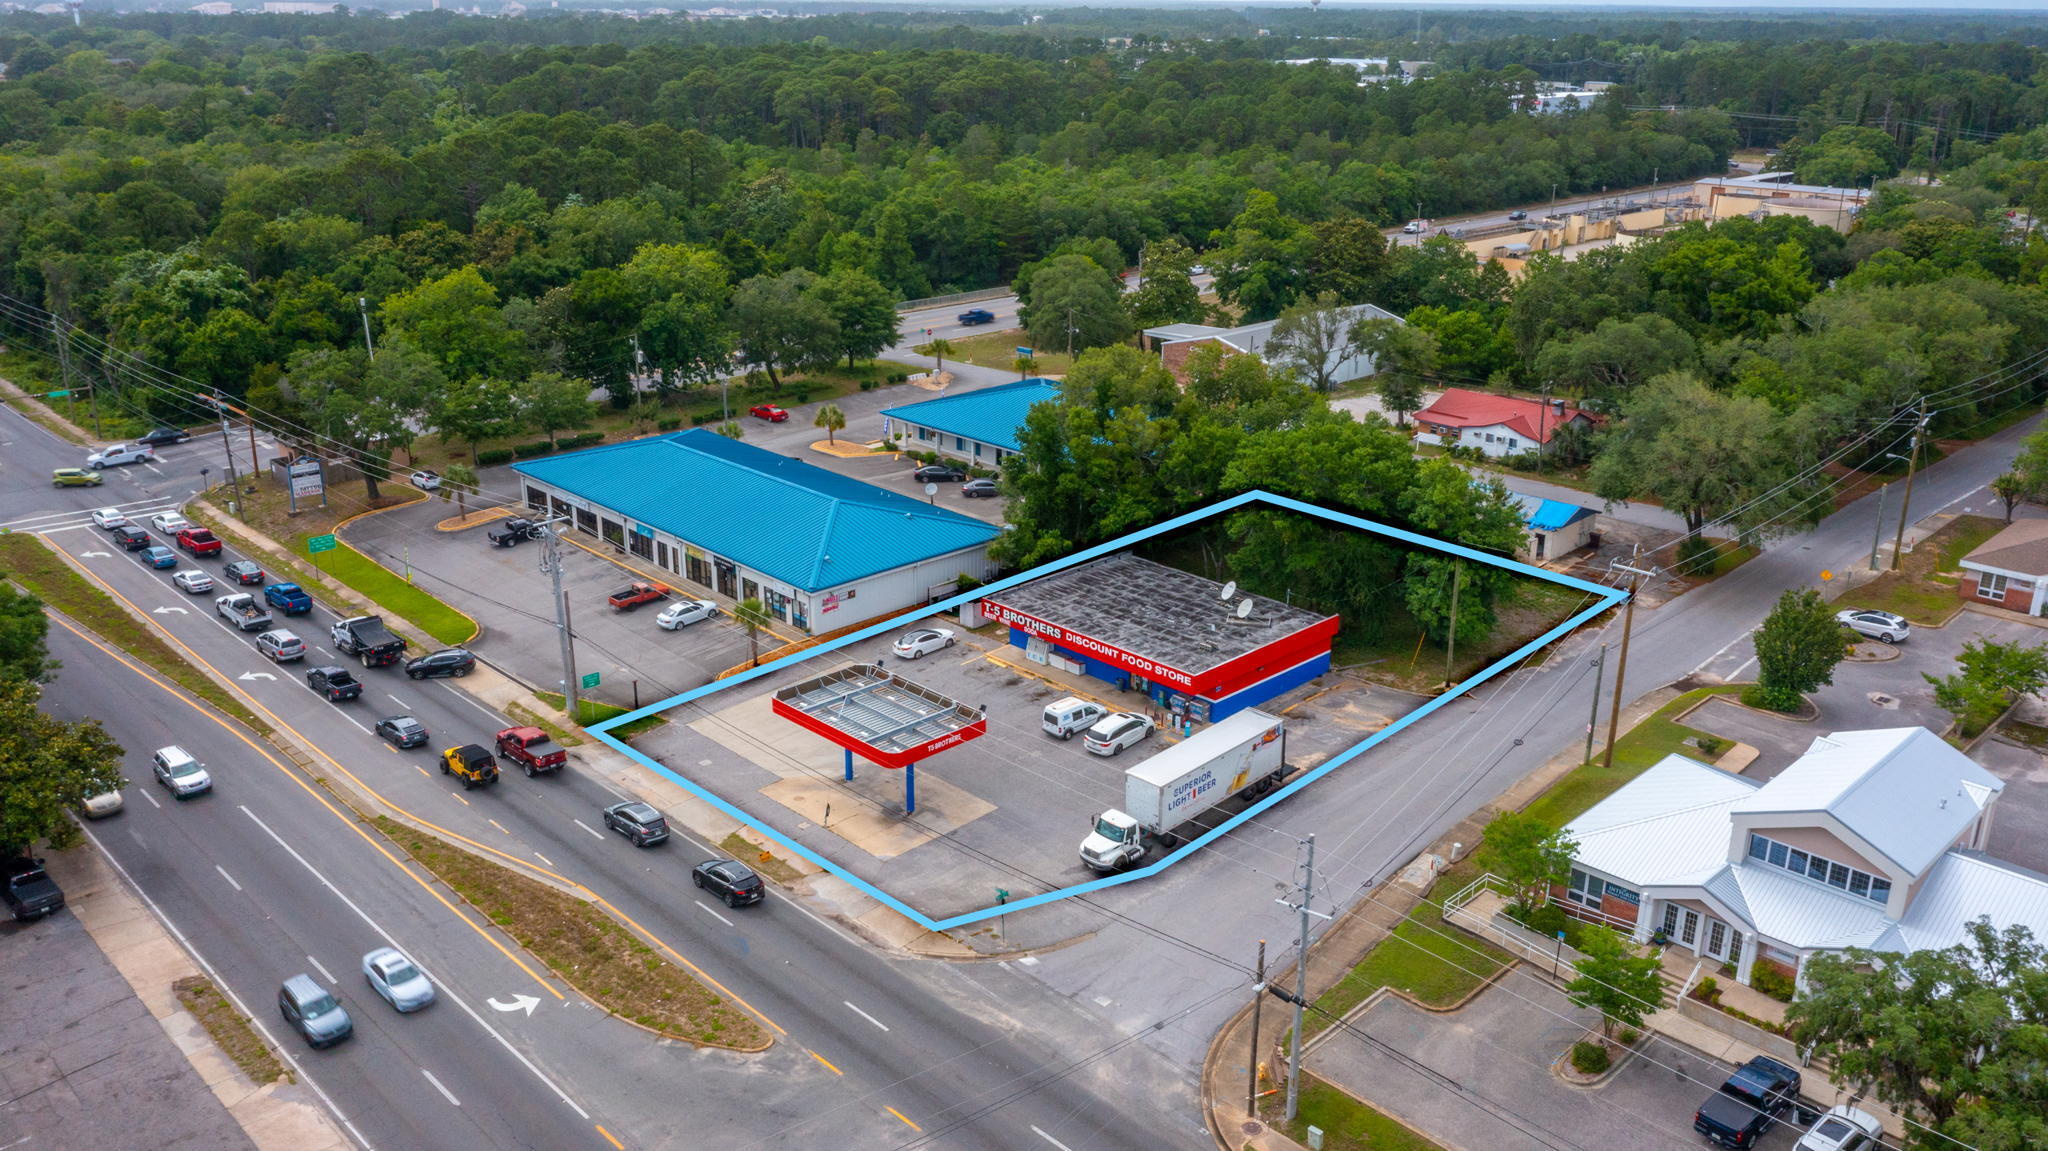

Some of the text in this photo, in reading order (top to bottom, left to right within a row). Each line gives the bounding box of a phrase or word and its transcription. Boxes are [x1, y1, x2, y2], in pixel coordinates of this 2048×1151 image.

[984, 602, 1192, 686] T-5 BROTHERS DISCOUNT FOOD STORE
[1168, 791, 1191, 811] LIGHT
[1197, 778, 1216, 795] BEER
[1173, 770, 1212, 797] SUPERIOR
